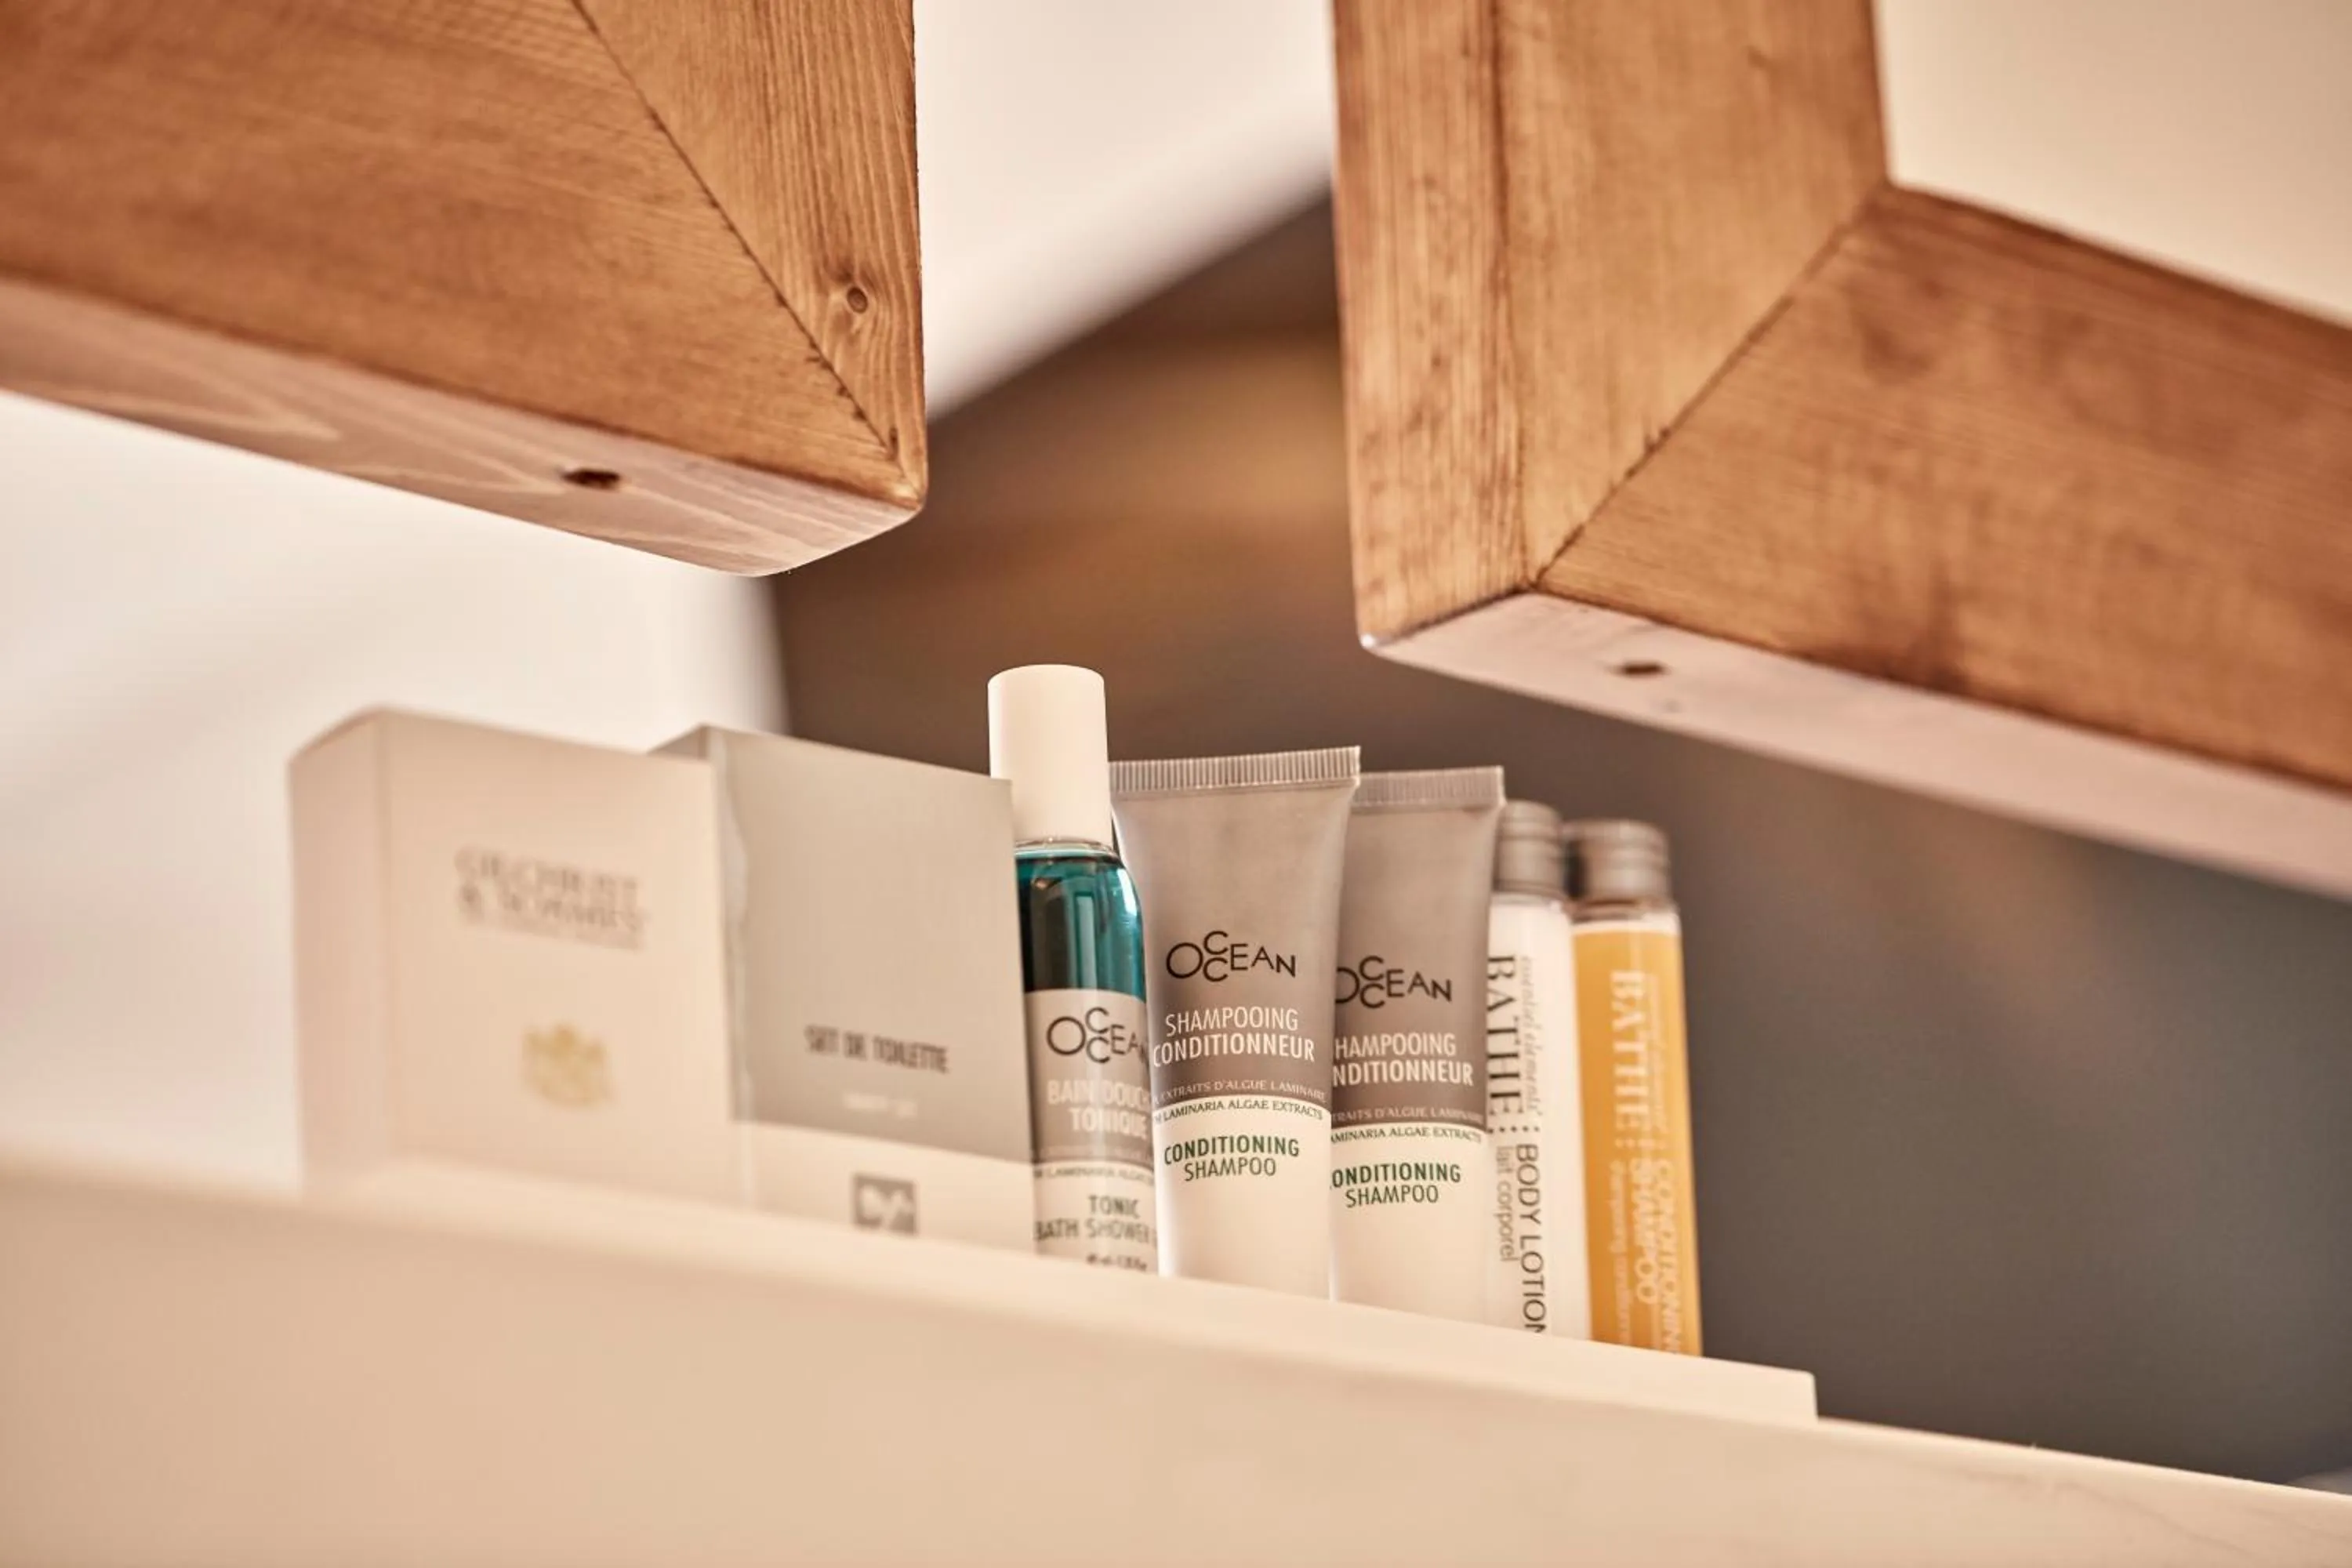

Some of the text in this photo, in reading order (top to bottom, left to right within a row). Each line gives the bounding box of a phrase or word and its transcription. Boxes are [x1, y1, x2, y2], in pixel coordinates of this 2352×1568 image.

[1165, 1006, 1299, 1038] SHAMPOOING
[1487, 954, 1524, 1116] BATHE
[1153, 1033, 1316, 1068] CONDITIONNEUR
[1334, 1033, 1457, 1061] HAMPOOING
[1333, 1059, 1473, 1087] NDITIONNEUR
[1163, 1100, 1225, 1122] LAMINARIA
[1228, 1099, 1269, 1111] ALGAE
[1164, 1134, 1300, 1165] CONDITIONING
[1331, 1128, 1386, 1143] AMINARIA
[1184, 1157, 1277, 1181] SHAMPOO
[1332, 1162, 1461, 1190] ONDITIONING
[1345, 1185, 1439, 1208] SHAMPOO
[1515, 1143, 1542, 1225] BODY
[1087, 1194, 1141, 1220] TONIC
[1494, 1181, 1520, 1261] corporel
[1033, 1218, 1079, 1243] BATH
